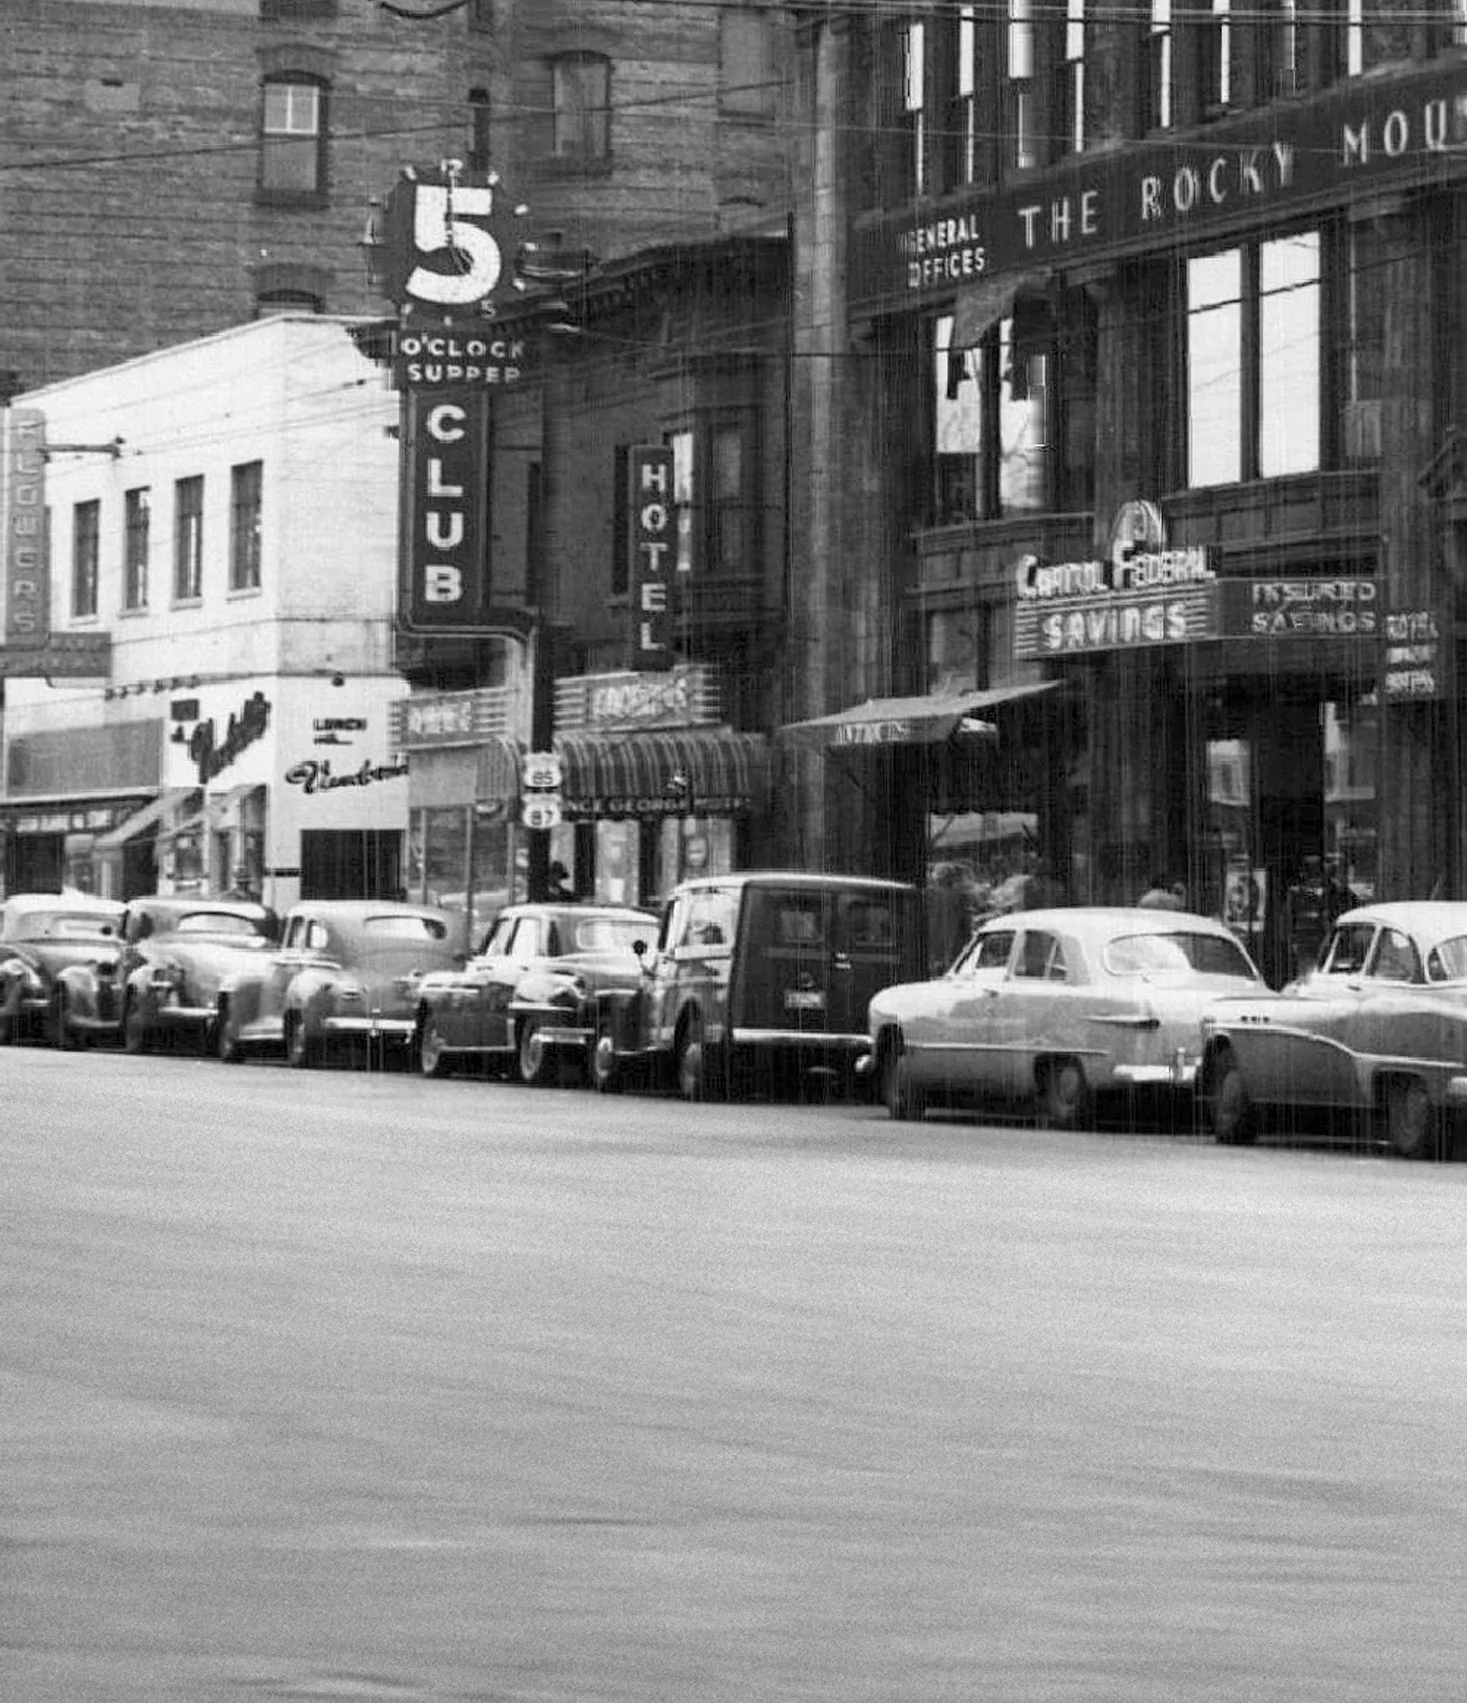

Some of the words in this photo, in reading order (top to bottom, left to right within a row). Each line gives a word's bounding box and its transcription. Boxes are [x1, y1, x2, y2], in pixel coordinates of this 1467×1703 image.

[1016, 190, 1099, 251] THE
[1141, 142, 1295, 222] ROCKY
[405, 184, 501, 304] 5
[902, 214, 981, 254] GENERAL
[907, 247, 986, 288] OFFICES
[400, 334, 526, 358] O'CLOCK
[407, 364, 522, 384] SUPPER
[424, 404, 468, 603] CLUB
[640, 463, 668, 651] HOTEL
[1041, 603, 1188, 650] SAVINGS
[608, 797, 688, 813] GEORGE
